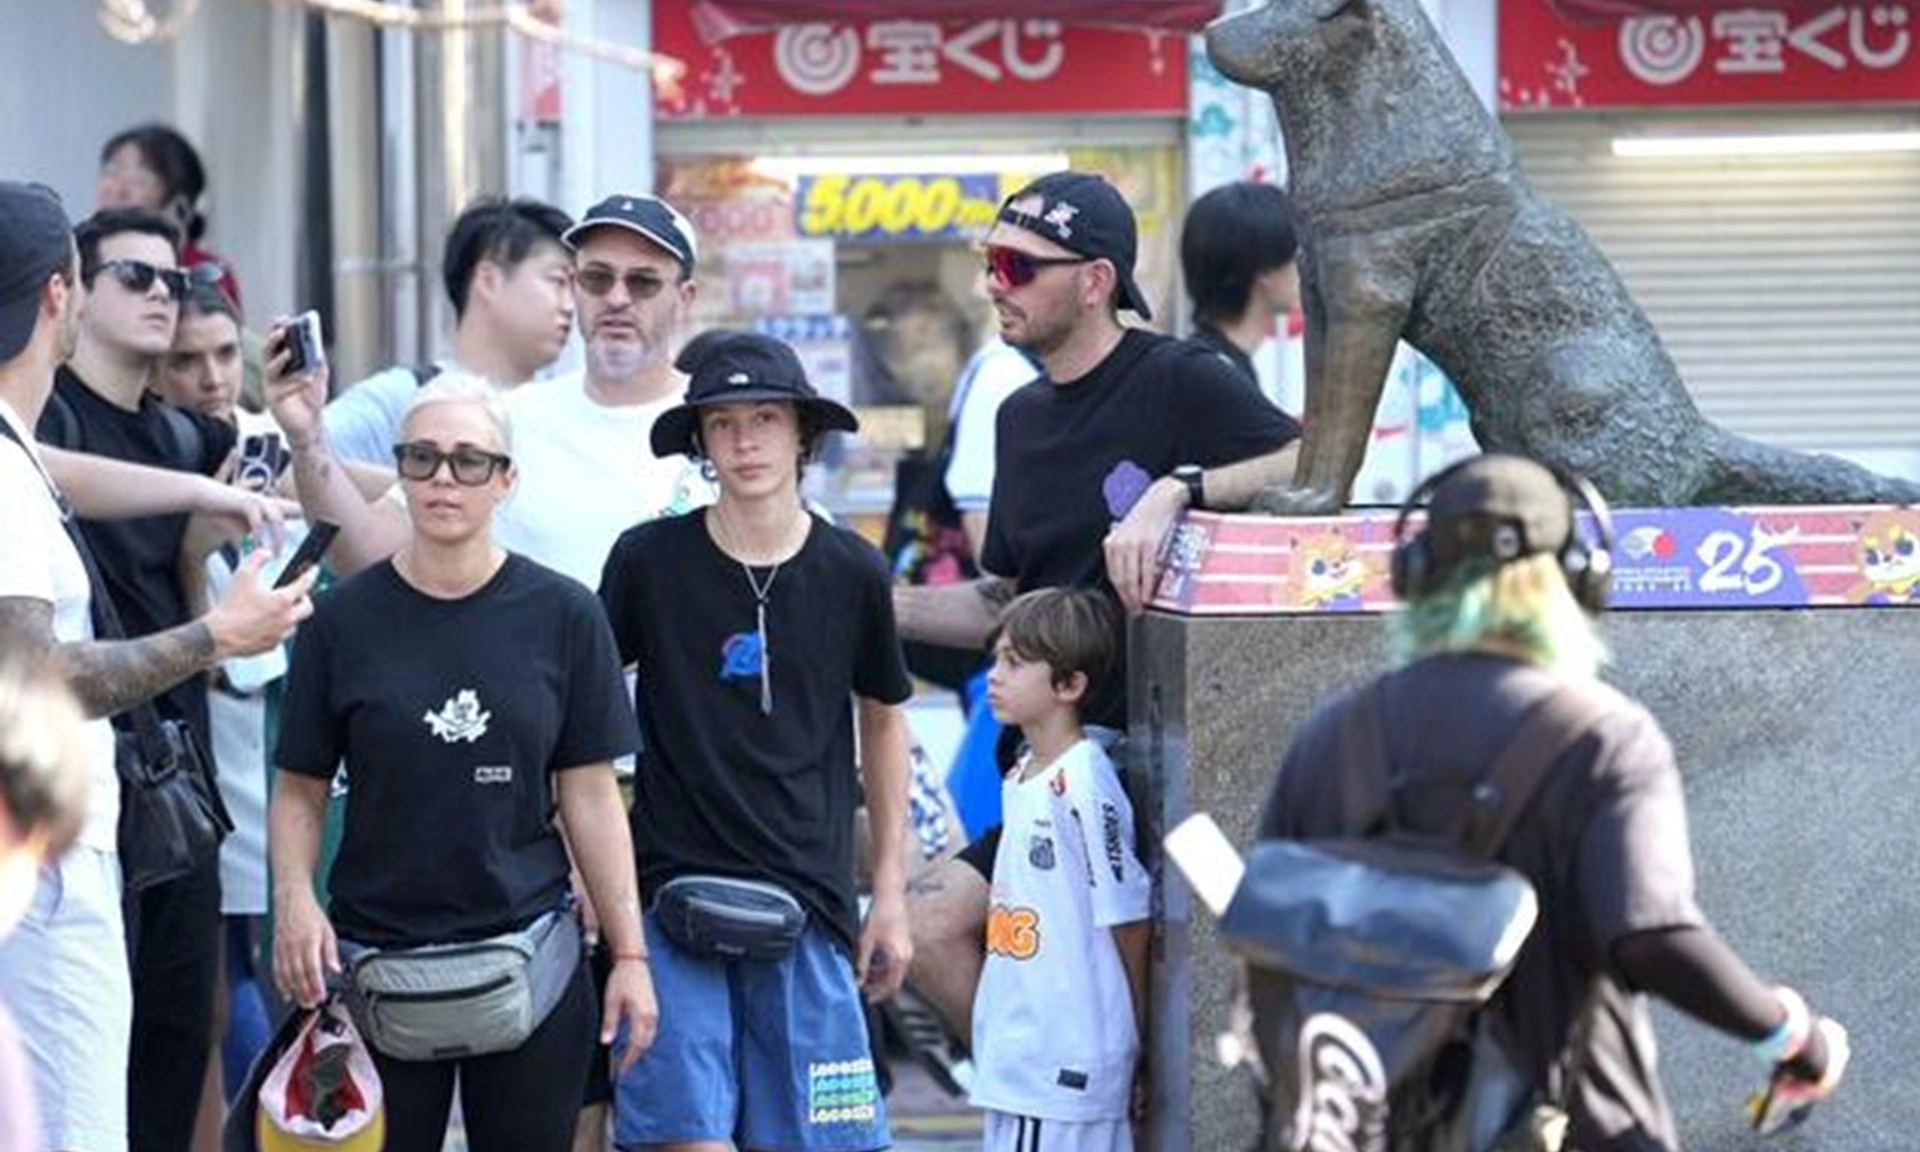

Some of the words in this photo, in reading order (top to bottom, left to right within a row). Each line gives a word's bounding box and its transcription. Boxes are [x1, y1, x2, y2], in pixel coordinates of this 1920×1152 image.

[868, 22, 1064, 83] 宝くじ
[1713, 7, 1910, 73] 宝くじ
[1697, 521, 1798, 596] 25
